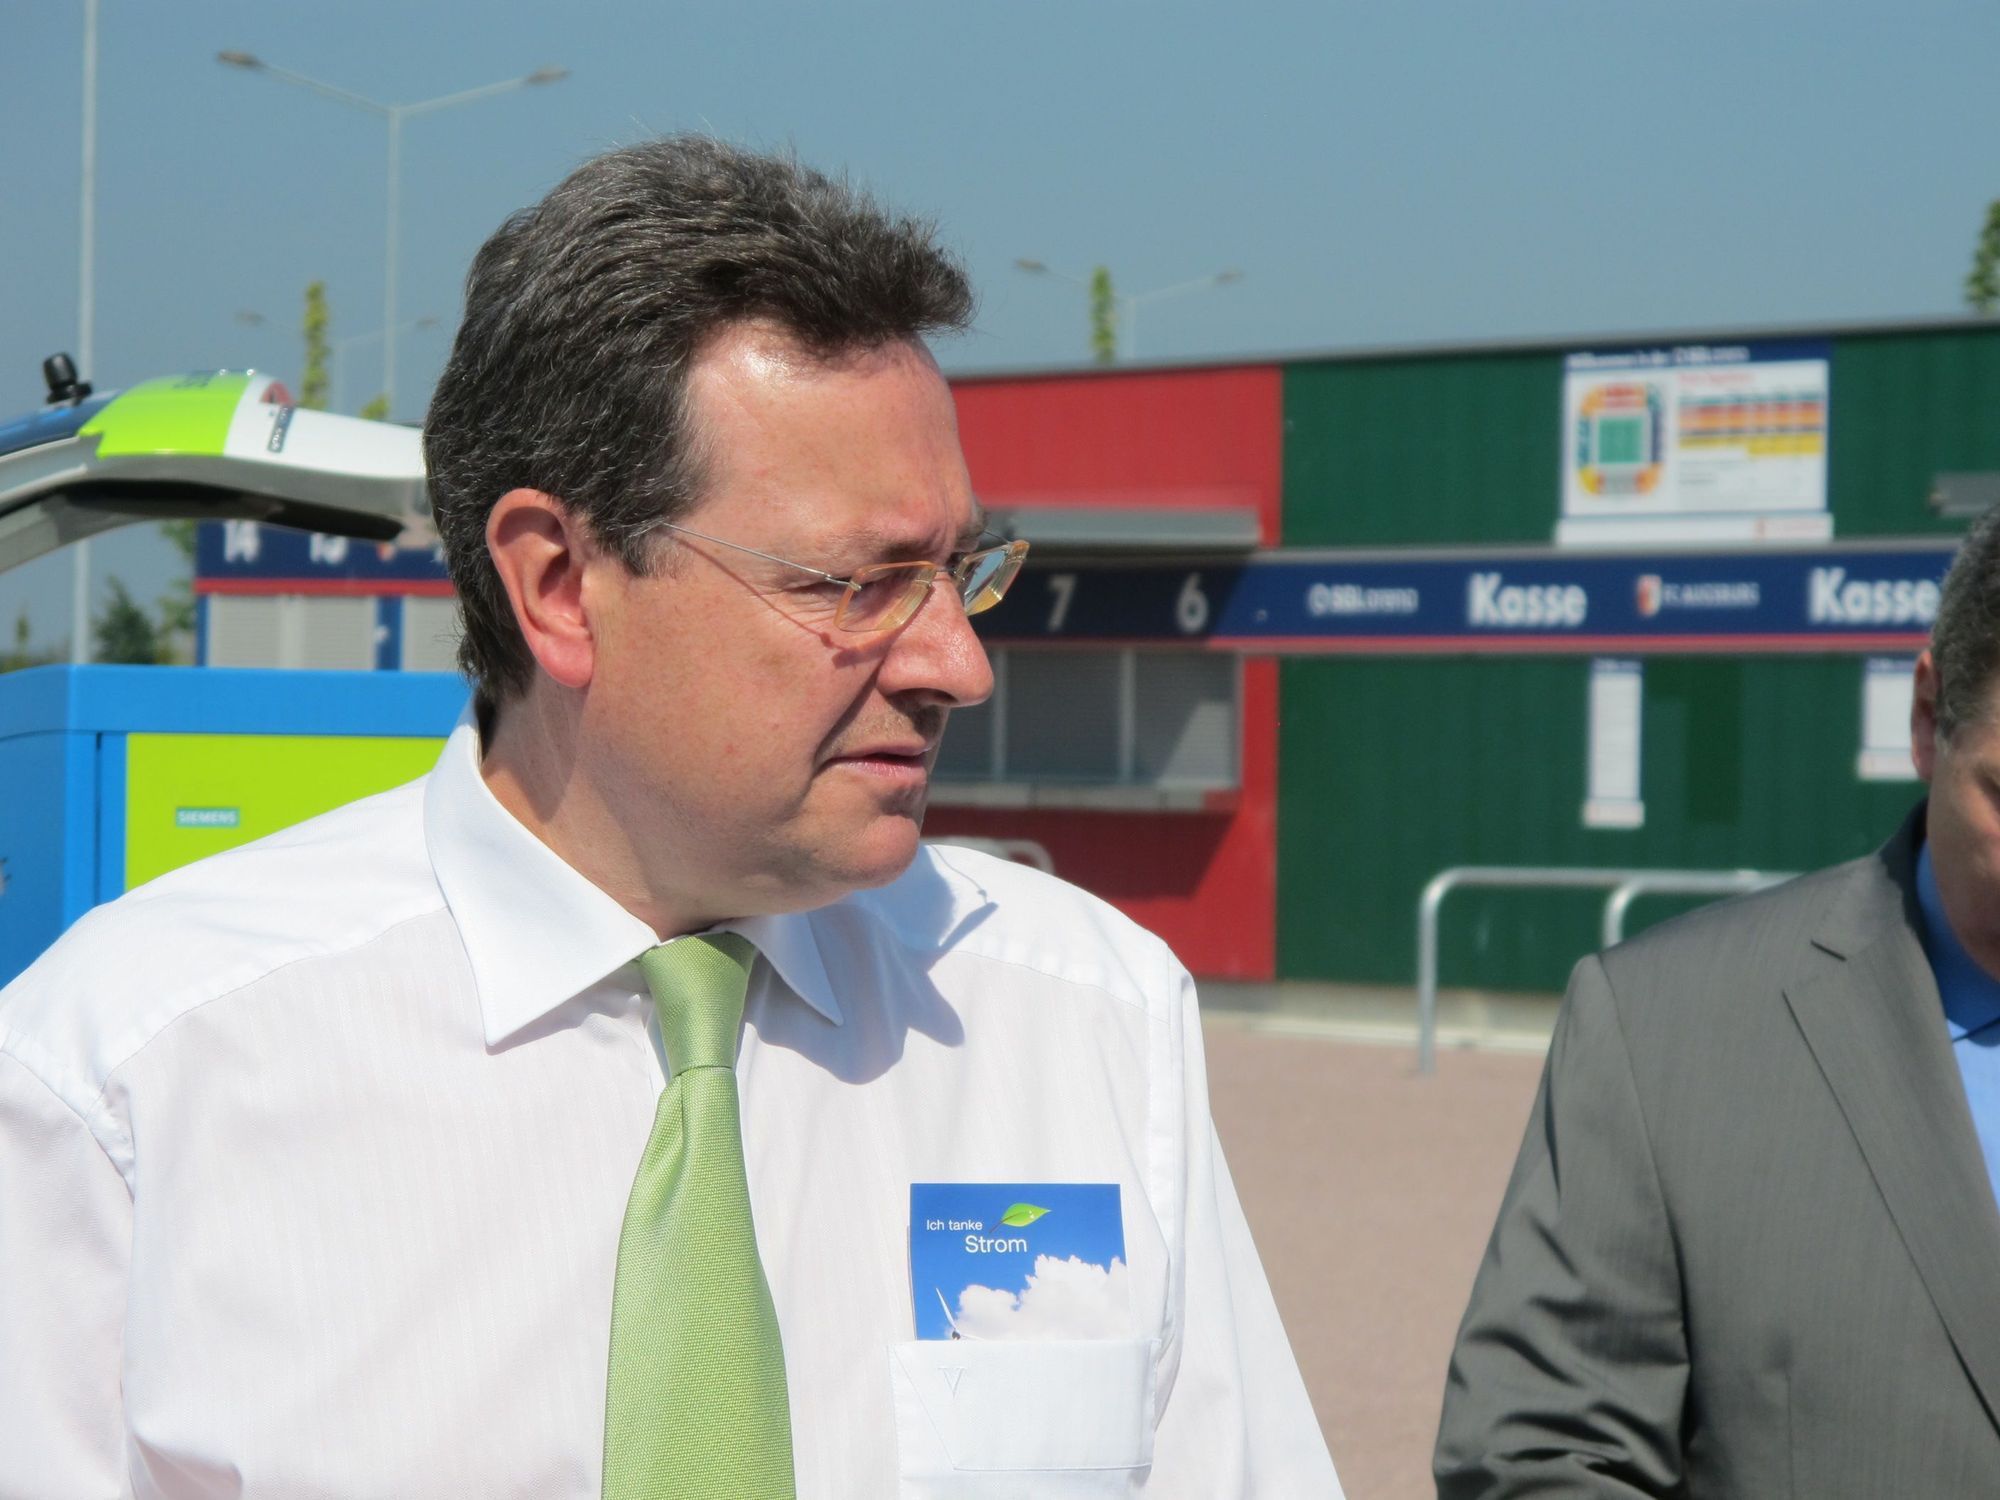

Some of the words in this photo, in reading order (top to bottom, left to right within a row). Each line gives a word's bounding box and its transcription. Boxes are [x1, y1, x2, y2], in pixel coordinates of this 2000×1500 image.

[1049, 574, 1077, 632] 7
[1176, 572, 1209, 632] 6
[1468, 571, 1588, 626] Kasse
[1809, 567, 1941, 624] Kasse
[179, 809, 237, 825] SIEMENS
[926, 1219, 945, 1231] Ich
[948, 1219, 983, 1231] tanke
[965, 1235, 1028, 1253] Strom
